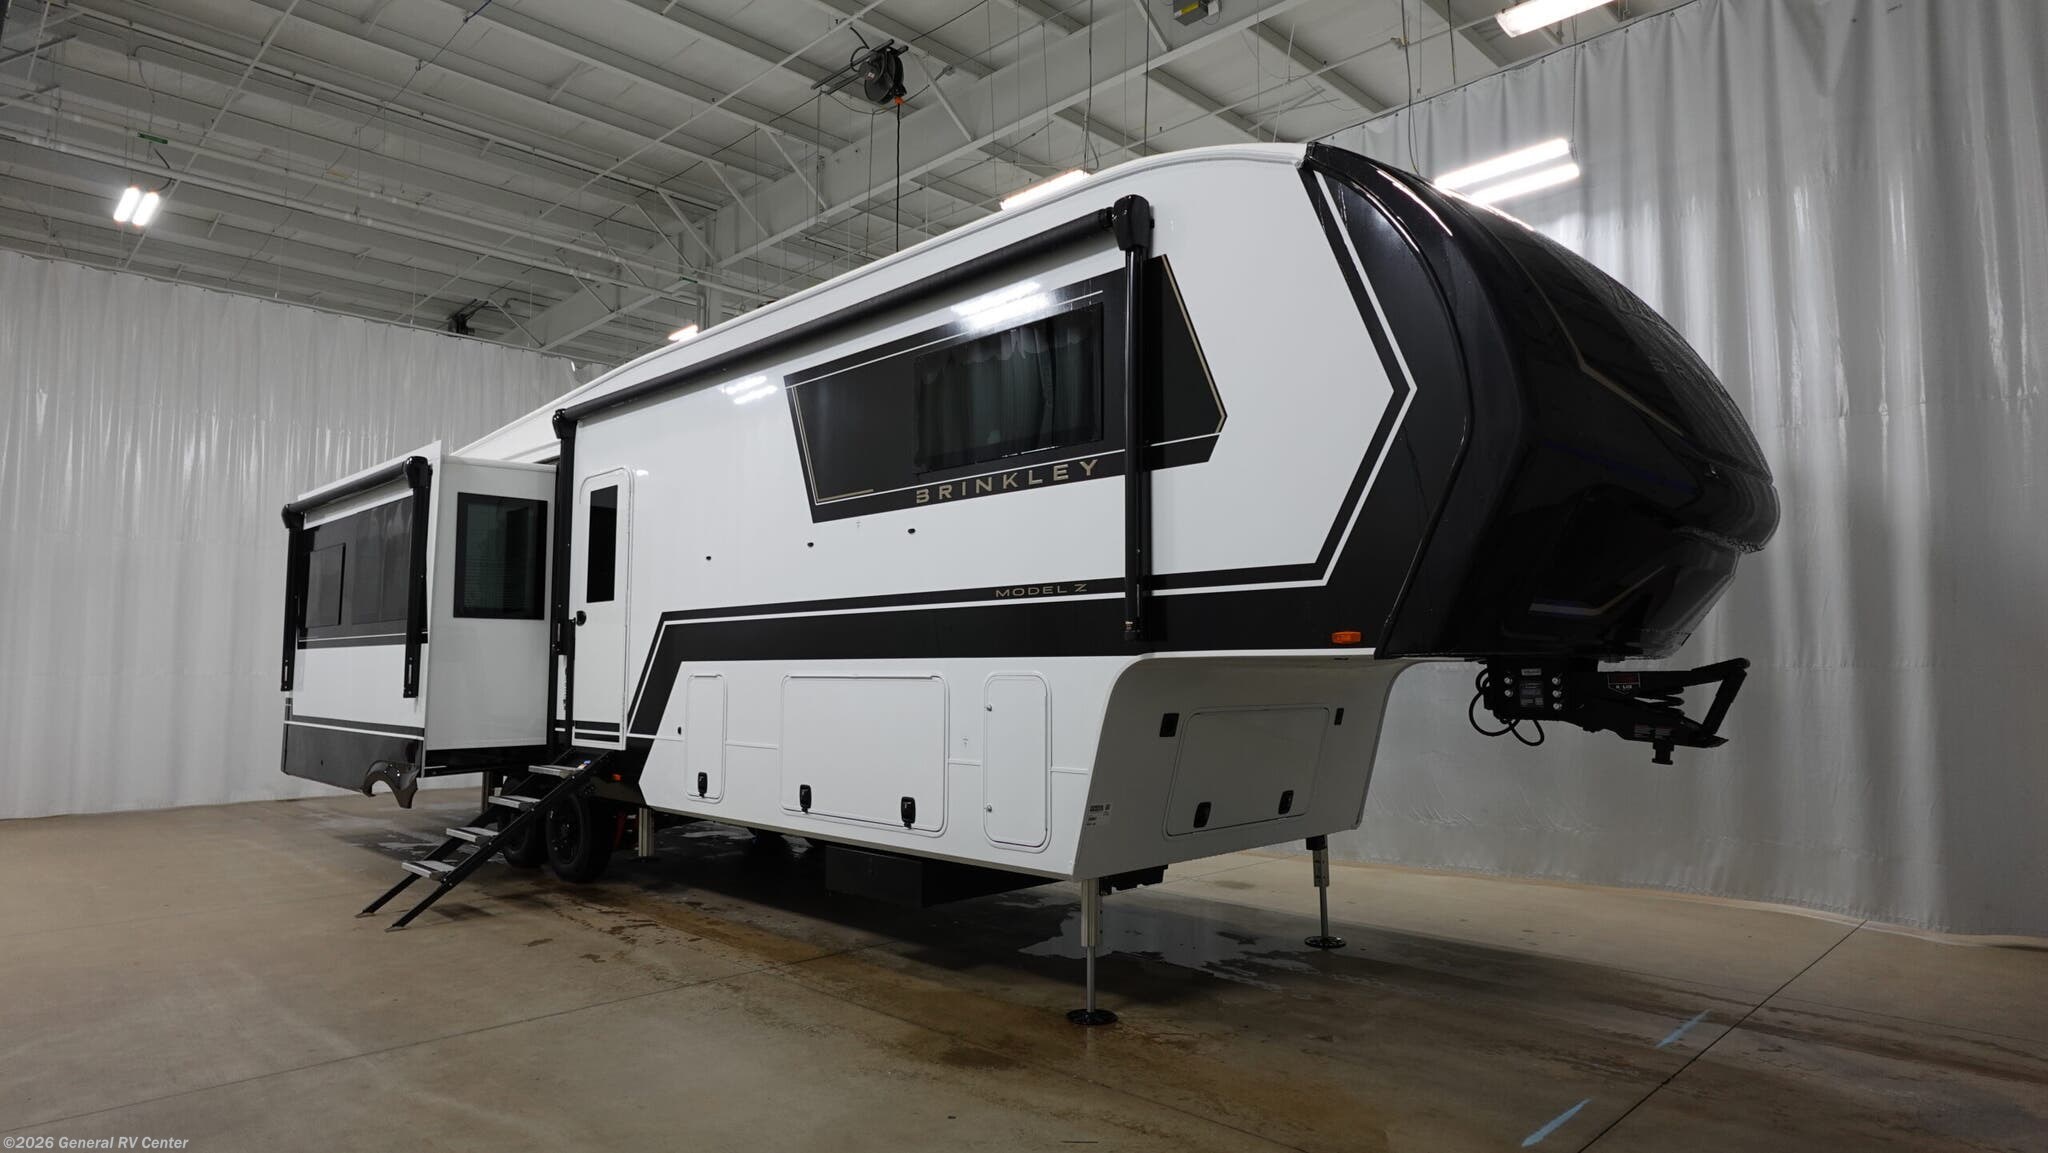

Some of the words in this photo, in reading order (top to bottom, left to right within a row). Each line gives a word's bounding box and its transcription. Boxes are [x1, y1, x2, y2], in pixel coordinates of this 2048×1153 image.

[915, 458, 1098, 504] BRINKLEY
[995, 585, 1068, 598] MODEL
[1073, 583, 1088, 593] Z
